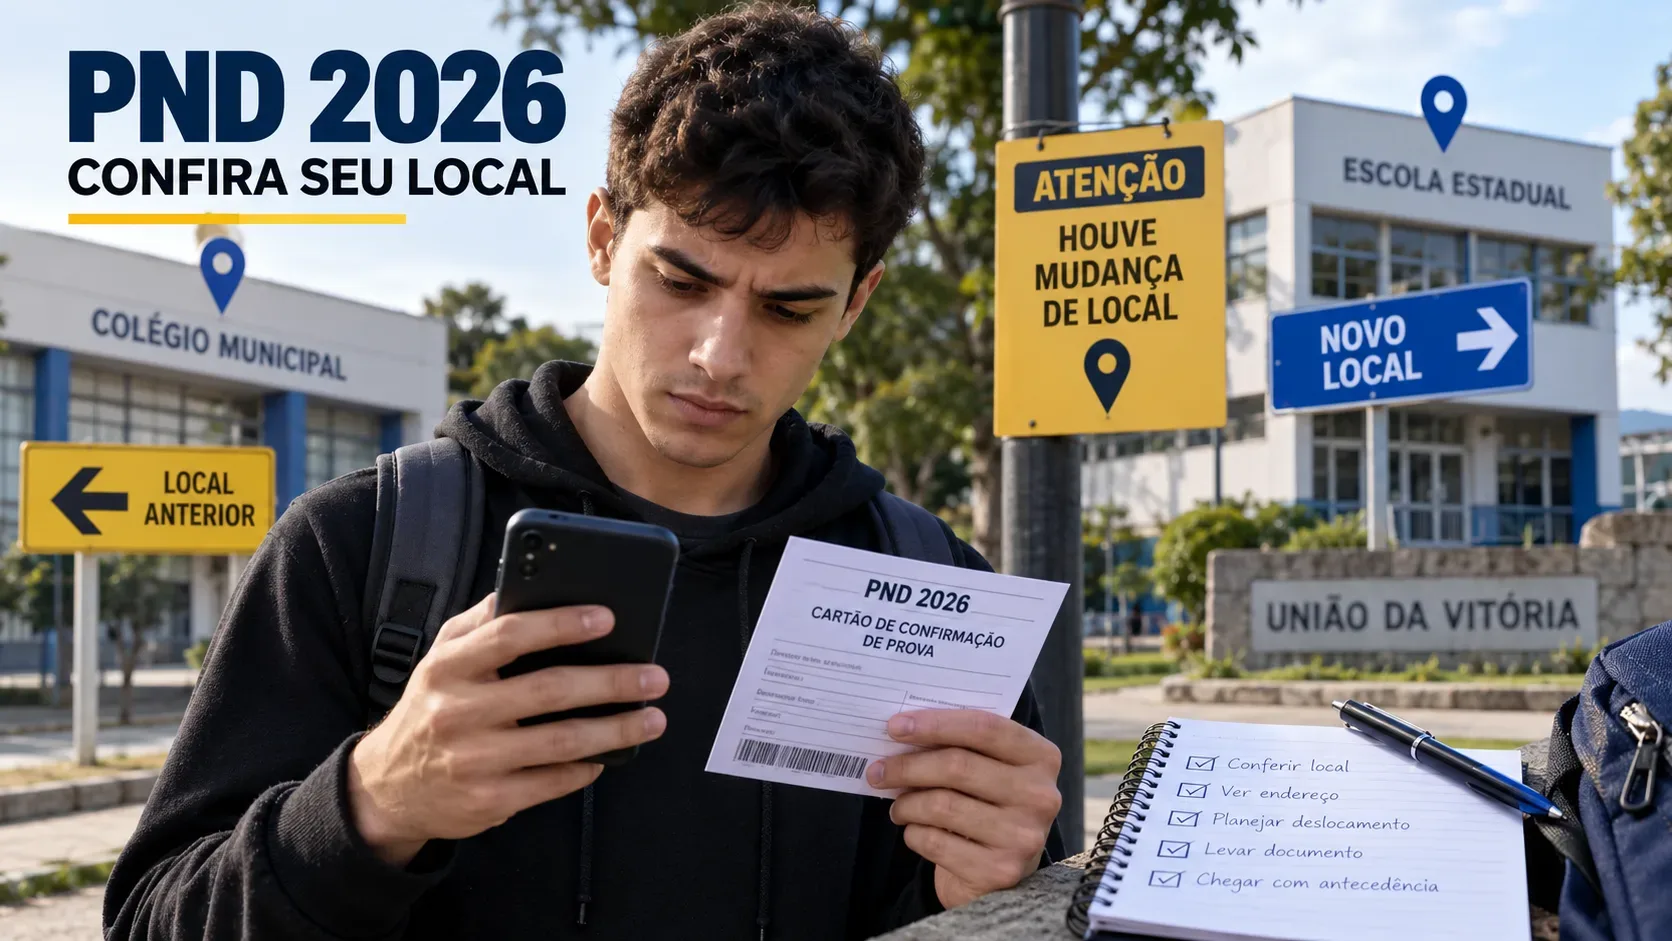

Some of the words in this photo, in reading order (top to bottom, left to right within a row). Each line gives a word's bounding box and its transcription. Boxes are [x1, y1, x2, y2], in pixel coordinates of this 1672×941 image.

[1033, 153, 1187, 203] ATENÇÃO
[1343, 157, 1444, 194] ESCOLA
[1452, 172, 1571, 211] ESTADUAL
[1059, 218, 1158, 253] HOUVE
[1035, 253, 1184, 292] MUDANÇA
[1043, 299, 1082, 328] DE
[1087, 292, 1179, 326] LOCAL
[92, 309, 210, 354] COLÉGIO
[219, 332, 347, 381] MUNICIPAL
[1320, 315, 1405, 354] NOVO
[1322, 350, 1423, 391] LOCAL
[163, 470, 235, 495] LOCAL
[144, 502, 256, 527] ANTERIOR
[864, 578, 912, 605] PND
[916, 587, 971, 614] 2026
[1266, 595, 1367, 633] UNIÃO
[1384, 604, 1429, 631] DA
[1444, 591, 1580, 631] VITÓRIA
[811, 605, 872, 629] CARTÃO
[875, 617, 896, 633] DE
[898, 621, 1005, 650] CONFIRMAÇÃO
[862, 634, 884, 650] DE
[886, 638, 934, 658] PROVA
[1227, 757, 1302, 773] Conferir
[1311, 758, 1350, 774] local
[1221, 785, 1251, 798] Ver
[1259, 787, 1340, 804] endereço
[1212, 811, 1284, 832] Planejar
[1292, 814, 1411, 832] deslocamento
[1205, 842, 1256, 858] Levar
[1264, 843, 1364, 860] documento
[1197, 871, 1263, 893] Chegar
[1272, 877, 1310, 891] com
[1319, 877, 1439, 894] antecedência
